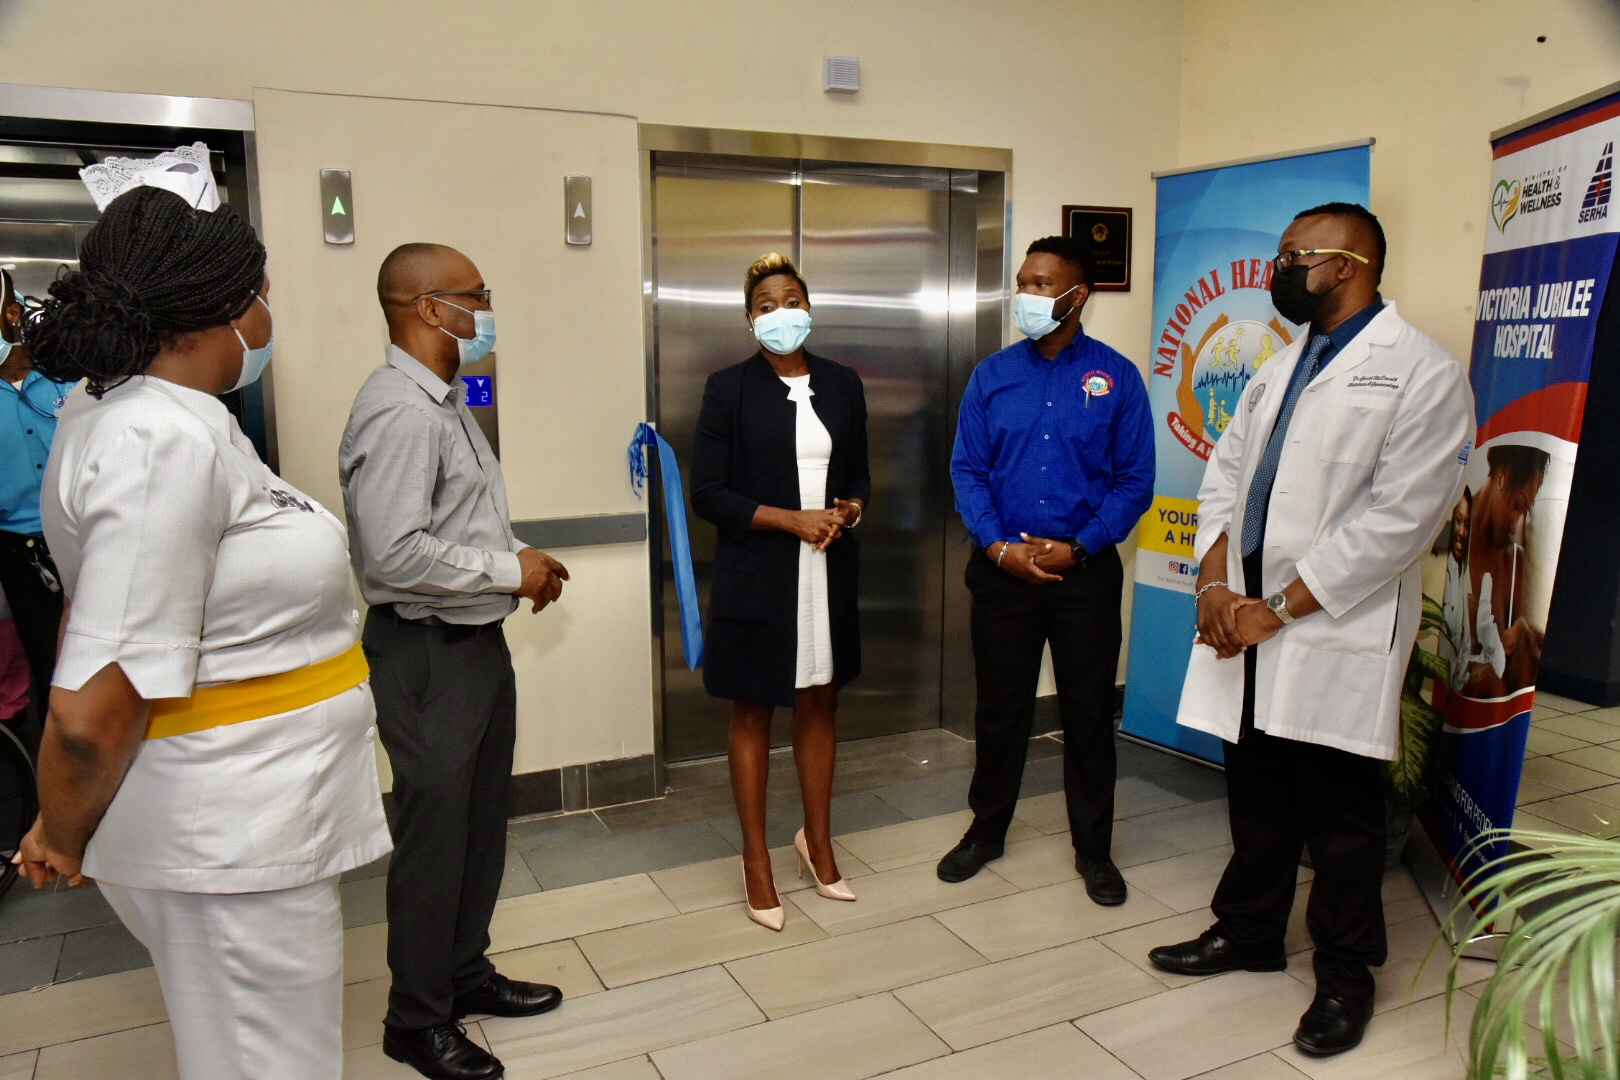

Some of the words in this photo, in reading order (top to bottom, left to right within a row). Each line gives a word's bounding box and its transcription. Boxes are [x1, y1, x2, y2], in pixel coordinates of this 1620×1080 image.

[1525, 169, 1555, 182] MINISTRY
[1558, 165, 1567, 173] OF
[1522, 178, 1553, 198] HEALTH
[1554, 176, 1561, 190] &
[1520, 192, 1562, 215] WELLNESS
[1578, 205, 1608, 224] SERHA
[1476, 286, 1531, 321] VICTORIA
[1533, 279, 1595, 319] JUBILEE
[1153, 269, 1226, 379] NATIONAL
[1231, 258, 1274, 291] HEA
[1494, 324, 1555, 359] HOSPITAL
[481, 391, 488, 402] 2
[1171, 417, 1197, 449] Taking
[1196, 443, 1205, 454] A
[1158, 508, 1198, 527] YOUR
[1164, 530, 1175, 543] A
[1460, 788, 1474, 820] FOR
